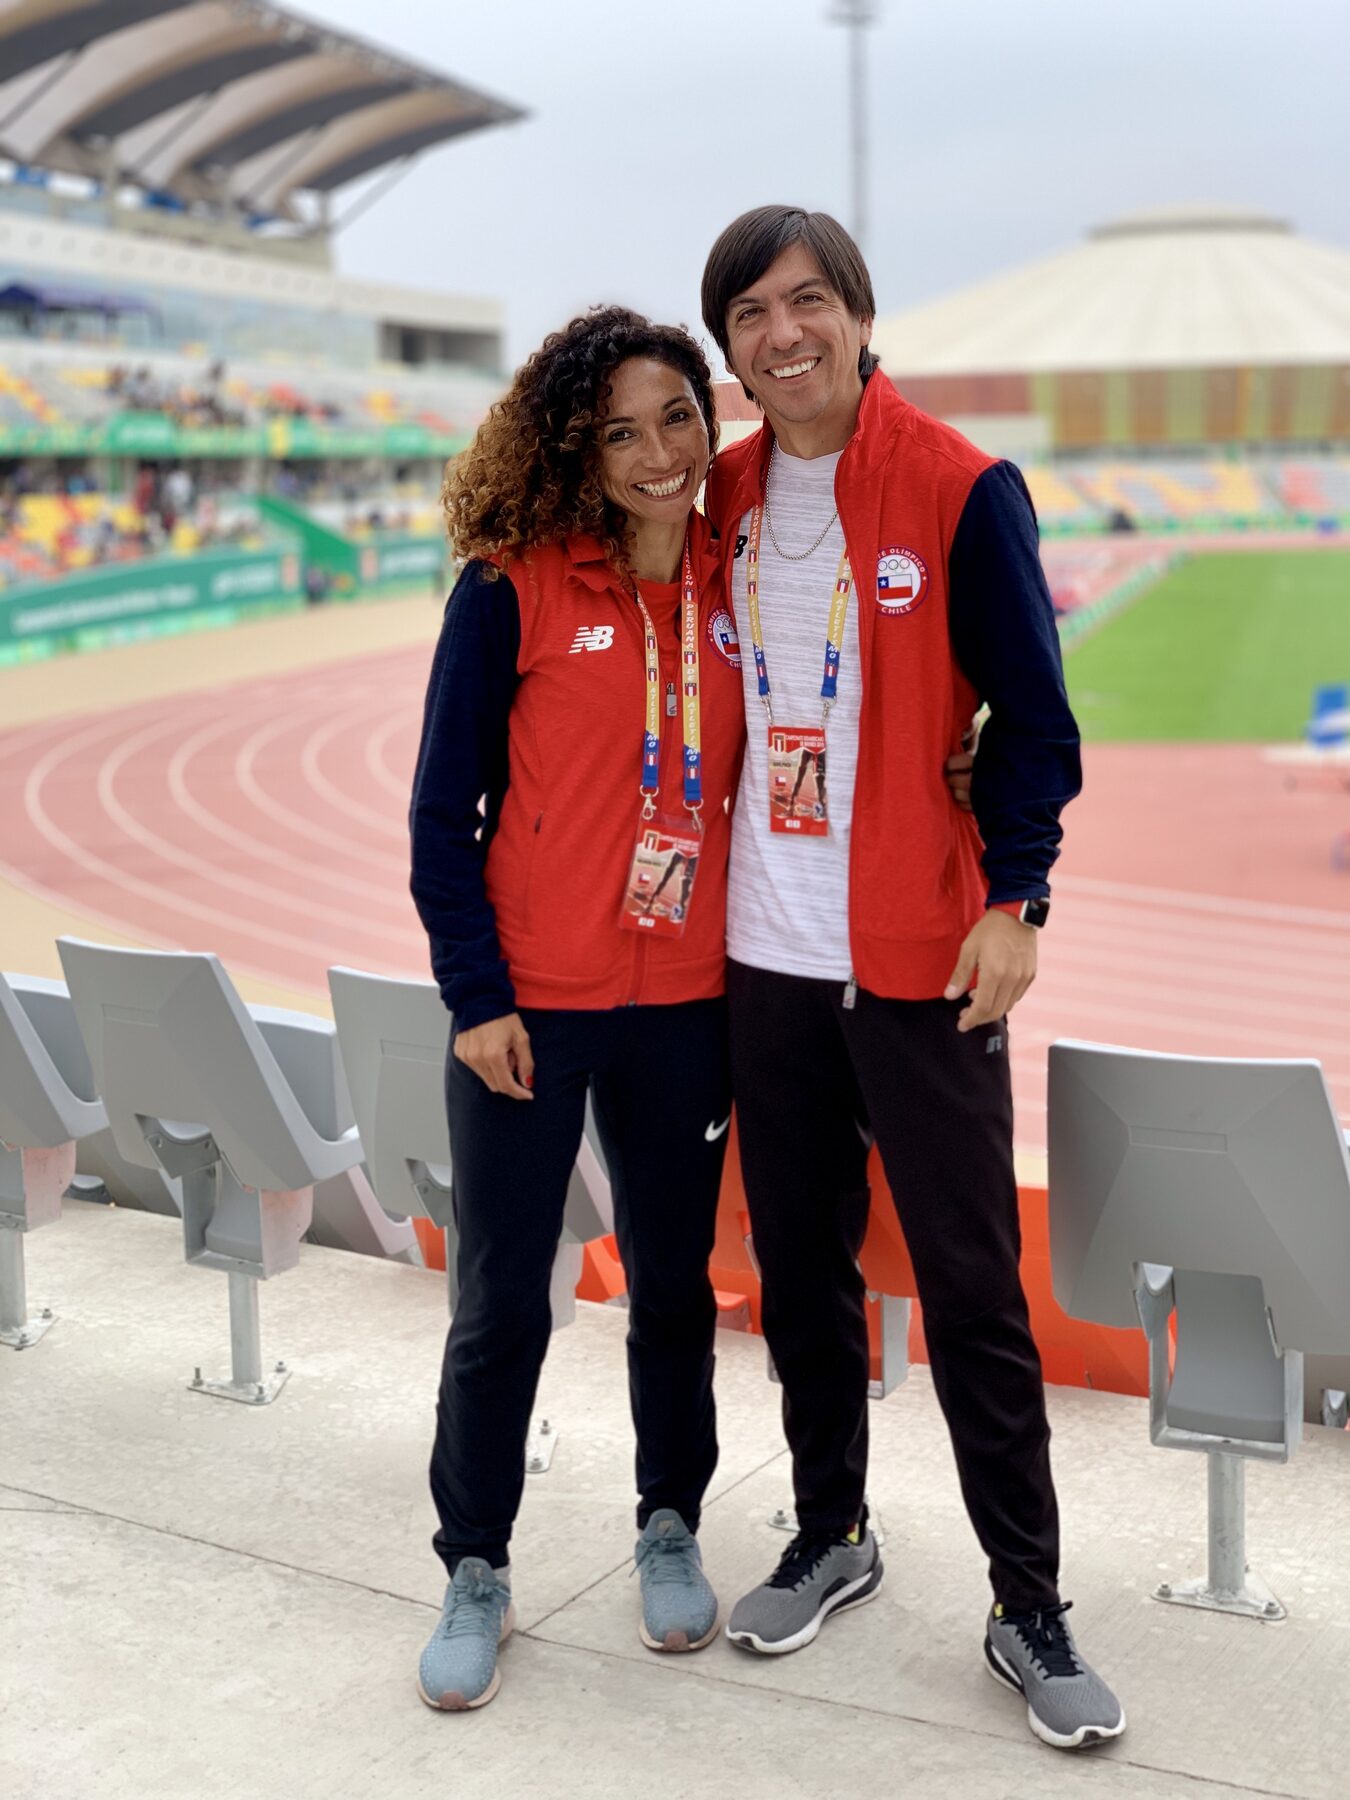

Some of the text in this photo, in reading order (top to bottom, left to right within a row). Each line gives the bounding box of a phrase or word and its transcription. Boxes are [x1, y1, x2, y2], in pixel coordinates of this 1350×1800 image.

[750, 504, 760, 548] ERUANA
[686, 604, 695, 649] PERUANA
[881, 604, 912, 615] CHILE
[568, 625, 615, 654] NB
